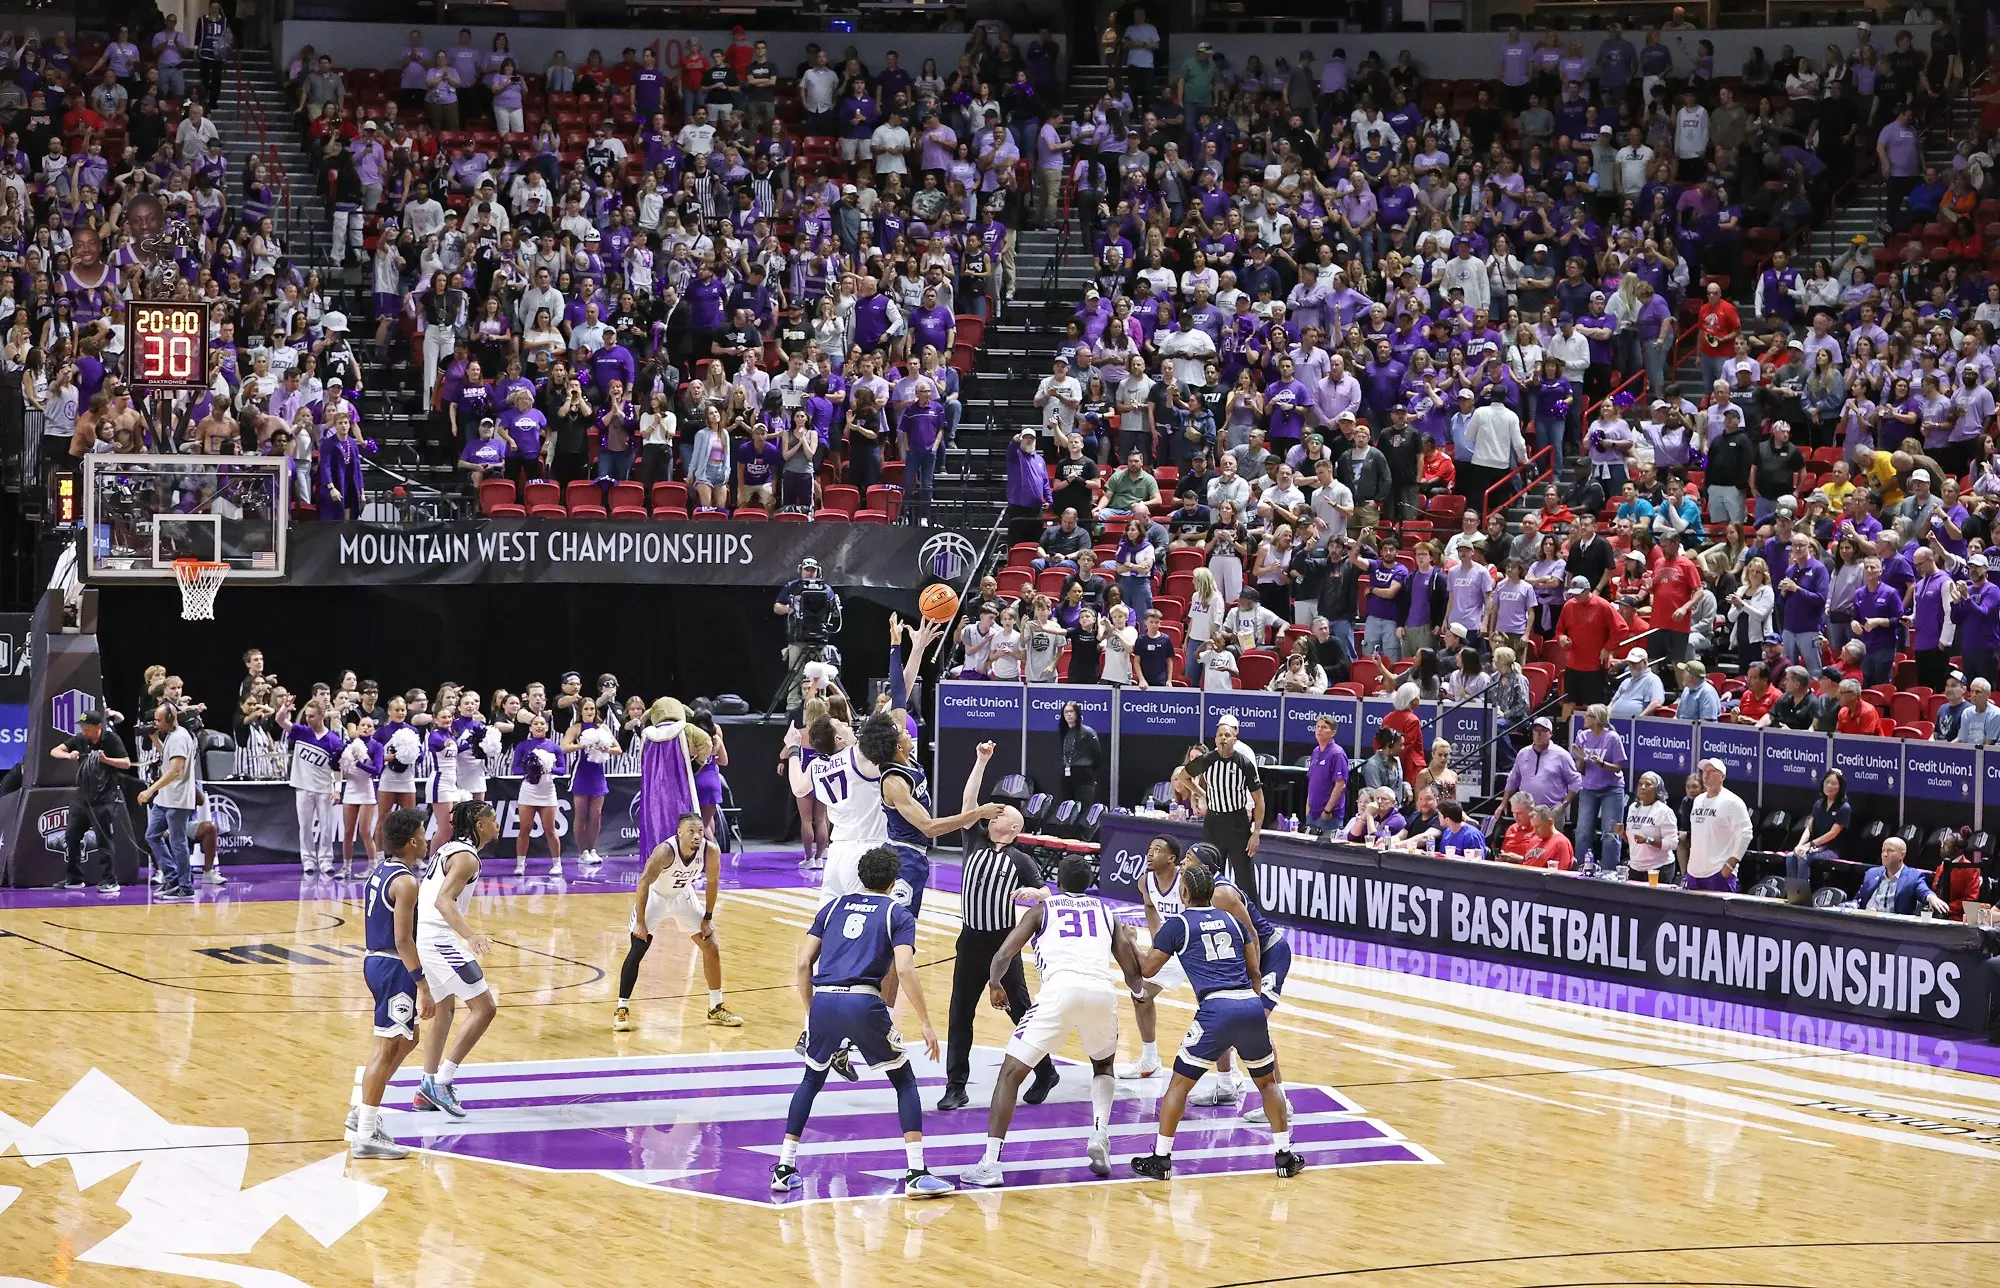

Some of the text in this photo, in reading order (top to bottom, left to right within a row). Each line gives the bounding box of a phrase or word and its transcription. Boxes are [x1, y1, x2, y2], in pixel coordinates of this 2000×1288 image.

[483, 249, 491, 260] 4
[136, 310, 199, 335] 20:00
[144, 336, 191, 377] 30
[1467, 344, 1484, 356] UP
[336, 362, 345, 376] 4
[340, 531, 753, 565] MOUNTAIN WEST CHAMPIONSHIPS
[1454, 577, 1472, 587] GCU
[1500, 591, 1520, 601] GCU
[944, 696, 977, 707] Credit
[979, 697, 1012, 708] Union
[1032, 699, 1064, 710] Credit
[1075, 700, 1102, 712] nion
[1123, 702, 1158, 713] Credit
[1160, 703, 1193, 715] Union
[967, 709, 996, 718] cu1.com
[1208, 705, 1240, 717] Credit
[1241, 707, 1272, 719] Union
[1146, 715, 1176, 724] cu1.com
[1457, 719, 1478, 731] CU1
[1454, 734, 1482, 743] cu1.com
[1637, 735, 1662, 748] Credit
[1662, 736, 1686, 750] Union
[1703, 740, 1728, 754] Credit
[1728, 742, 1753, 757] Union
[1766, 746, 1793, 760] Credit
[1794, 748, 1819, 763] Union
[299, 747, 328, 768] GCU
[1836, 753, 1864, 767] Credit
[1866, 756, 1893, 770] Union
[1908, 759, 1938, 773] Credit
[1939, 761, 1967, 776] Union
[819, 769, 849, 805] 17
[40, 814, 60, 833] OLD
[216, 835, 254, 848] ONSHIPS
[671, 870, 699, 878] GCU
[1110, 849, 1134, 885] Las
[844, 902, 879, 913] LOWERY
[1048, 897, 1100, 909] OWUSU-ANANE
[1157, 900, 1179, 914] GCU
[842, 913, 868, 940] 6
[1057, 909, 1098, 939] 31
[1199, 919, 1227, 931] COMER
[1224, 853, 1961, 1019] UNTAIN WEST BASKETBALL CHAMPIONSHIPS
[1201, 932, 1237, 962] 12
